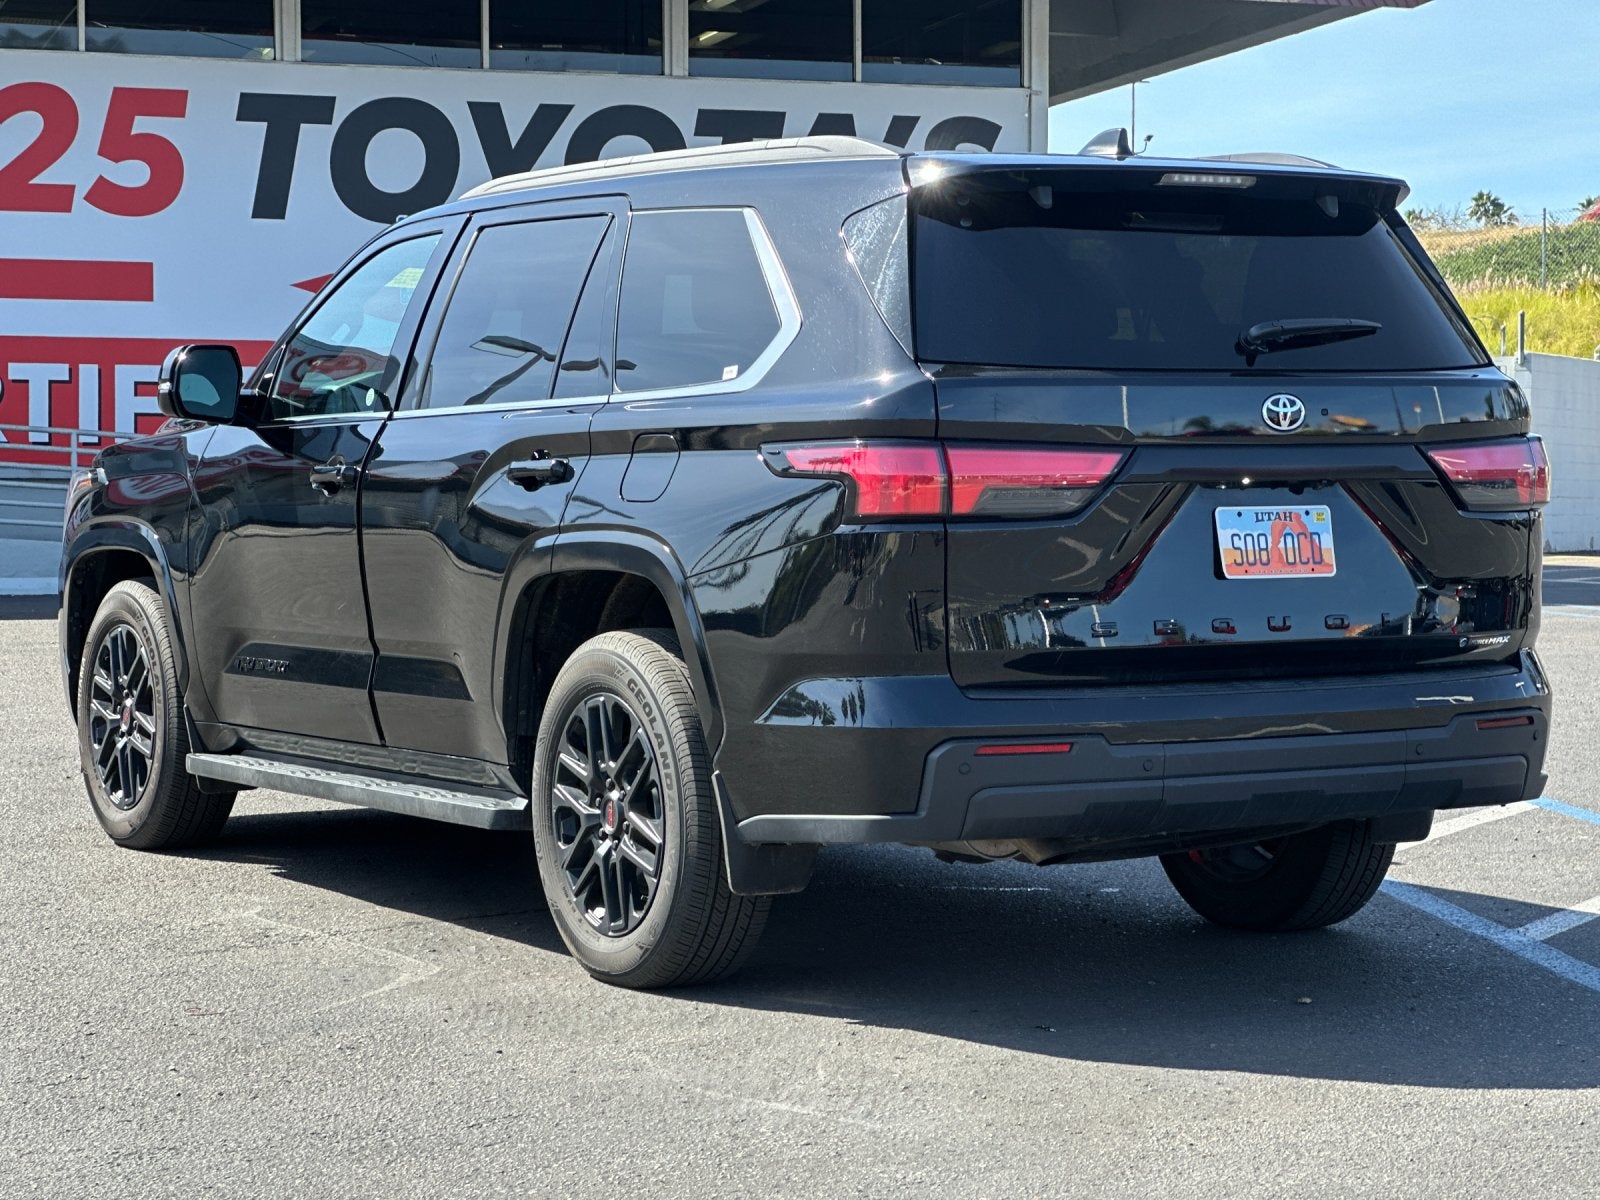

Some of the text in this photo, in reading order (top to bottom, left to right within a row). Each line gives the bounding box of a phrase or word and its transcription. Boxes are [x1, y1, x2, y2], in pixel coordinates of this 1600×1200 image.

[0, 82, 1002, 224] 25 TOY'
[1254, 511, 1294, 522] UTAH
[1091, 612, 1391, 638] SEQUOI
